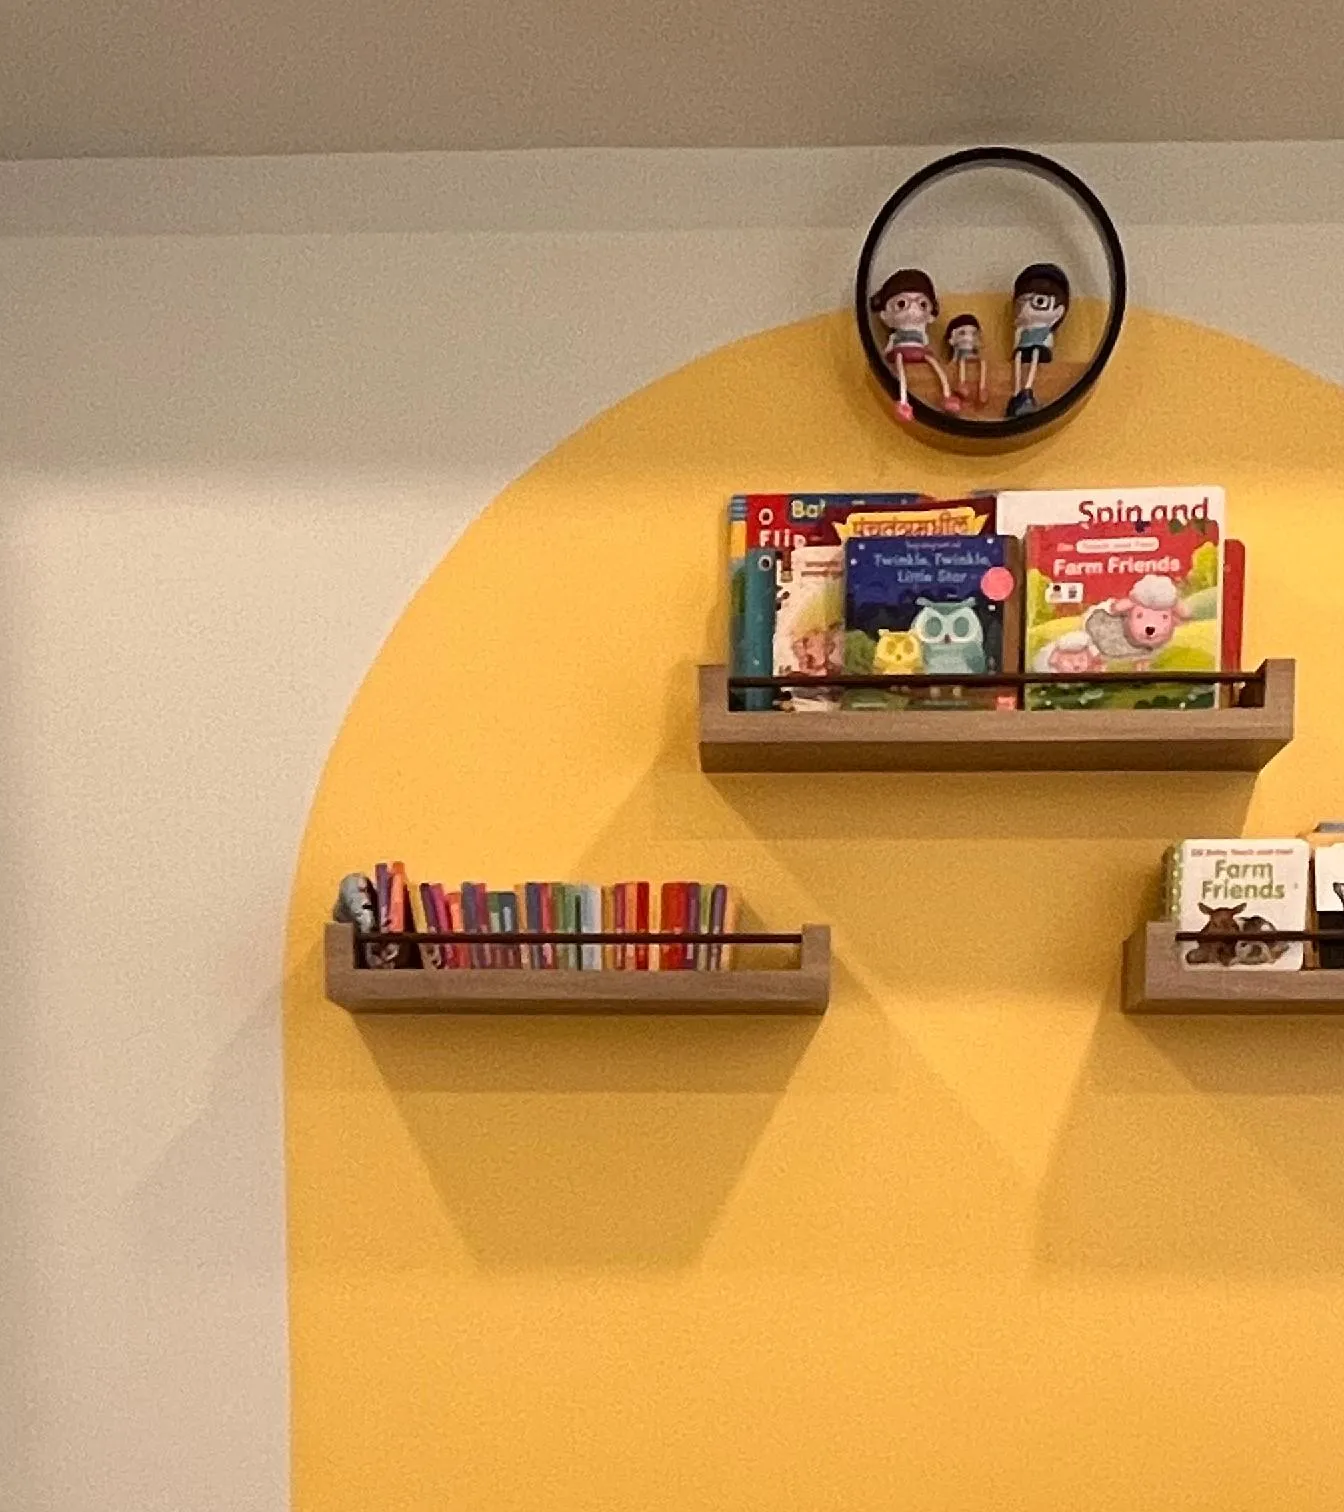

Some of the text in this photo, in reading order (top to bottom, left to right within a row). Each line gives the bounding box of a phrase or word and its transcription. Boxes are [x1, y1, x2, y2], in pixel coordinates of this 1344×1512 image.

[1150, 497, 1209, 522] and
[936, 569, 968, 583] Star
[1053, 556, 1180, 576] Farm Friends
[1215, 859, 1273, 879] Farm
[1202, 879, 1285, 899] Friends
